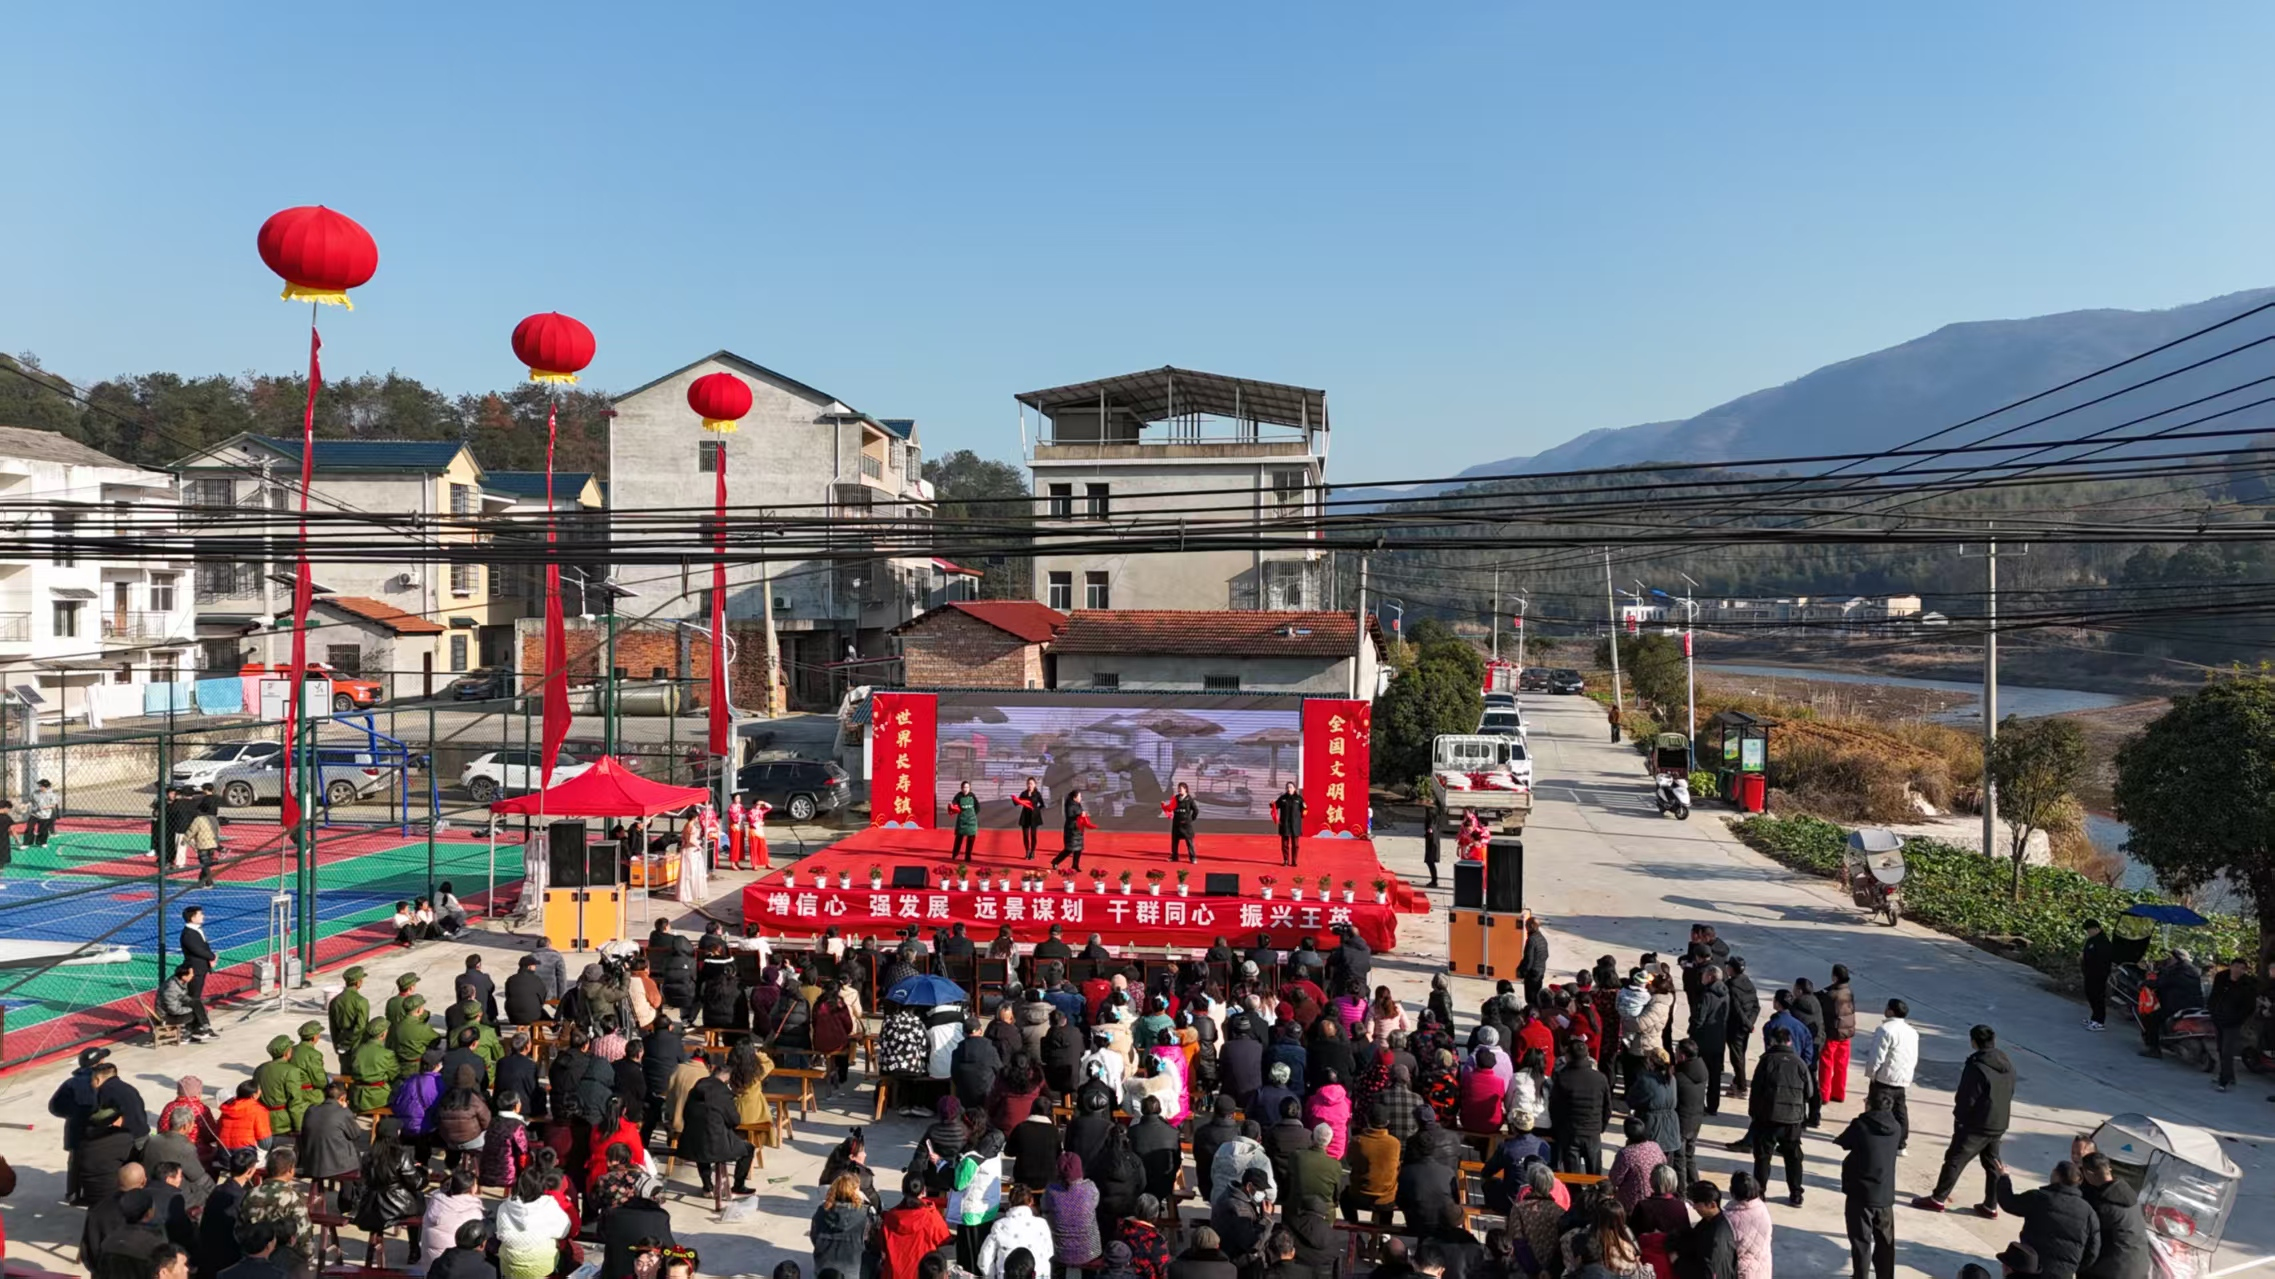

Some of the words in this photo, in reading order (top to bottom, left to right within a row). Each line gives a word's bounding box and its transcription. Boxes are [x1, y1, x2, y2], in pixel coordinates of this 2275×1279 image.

[894, 708, 913, 815] 世界长寿镇
[1326, 714, 1346, 824] 全国文明镇
[766, 892, 847, 917] 增信心
[869, 894, 950, 920] 强发展
[974, 896, 1083, 922] 远景谋划
[1107, 900, 1215, 926] 干群同心
